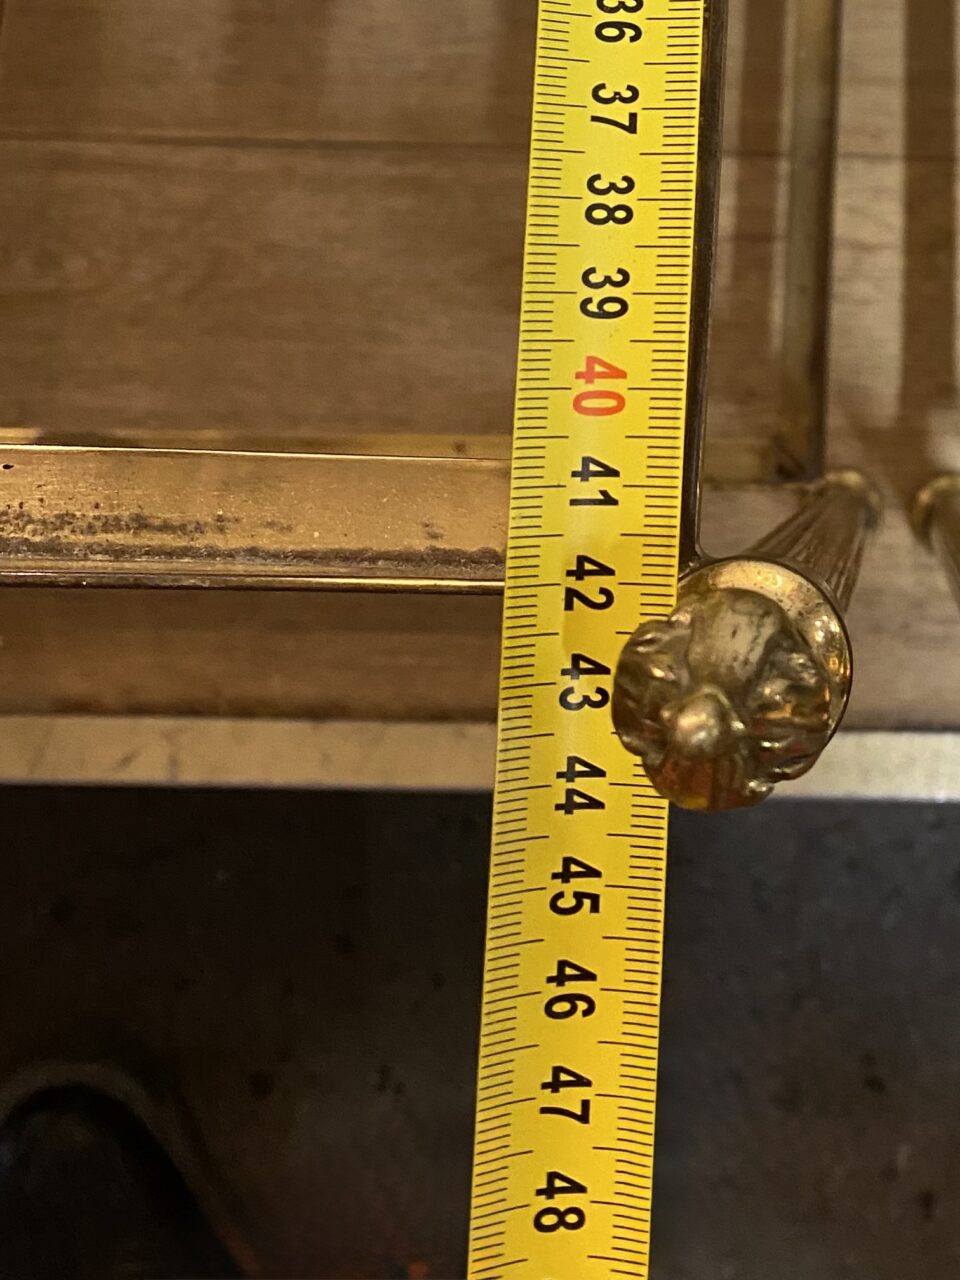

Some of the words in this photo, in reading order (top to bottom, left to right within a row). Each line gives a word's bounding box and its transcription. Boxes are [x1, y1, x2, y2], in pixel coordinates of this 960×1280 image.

[590, 83, 640, 135] 37
[584, 173, 635, 226] 38
[579, 267, 630, 320] 39
[573, 355, 627, 418] 40
[569, 456, 620, 506] 41
[563, 554, 616, 612] 42
[558, 653, 611, 711] 43
[554, 756, 607, 815] 44
[549, 856, 602, 916] 45
[544, 959, 598, 1020] 46
[539, 1065, 592, 1125] 47
[533, 1171, 588, 1233] 48
